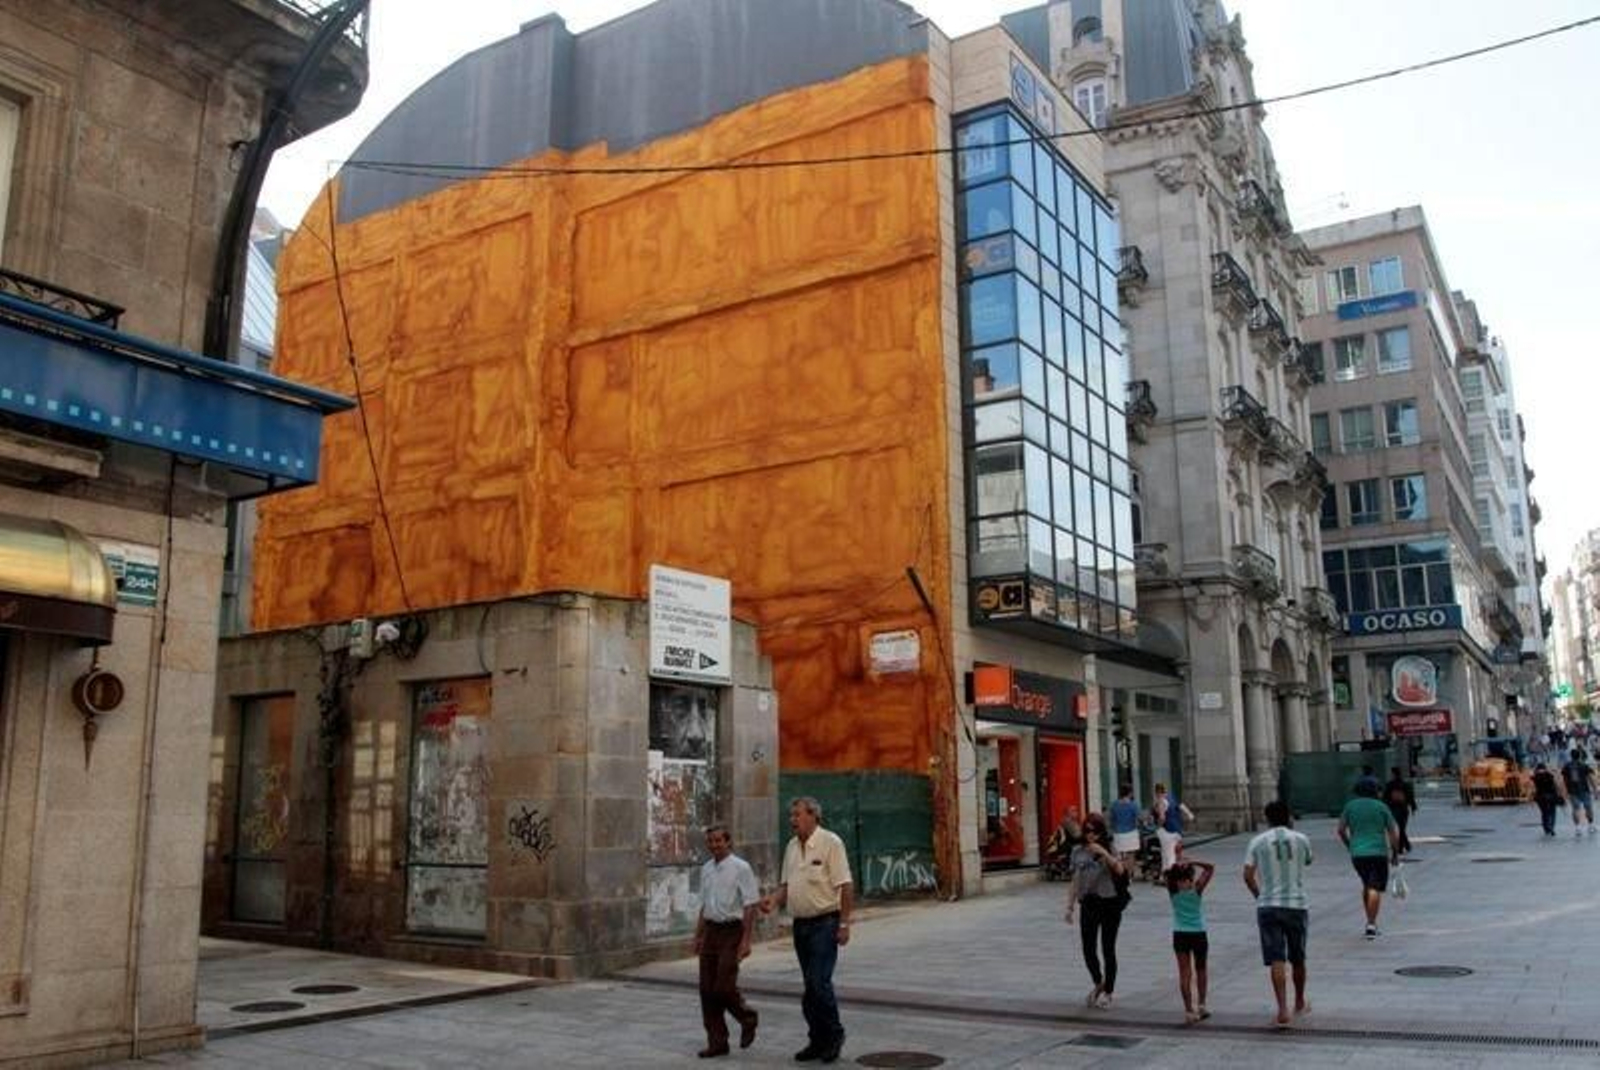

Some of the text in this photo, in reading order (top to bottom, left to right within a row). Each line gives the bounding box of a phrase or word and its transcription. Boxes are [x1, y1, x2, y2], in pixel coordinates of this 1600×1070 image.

[1363, 609, 1446, 631] OCASO
[1013, 684, 1053, 718] Orange
[1271, 839, 1293, 861] 11
